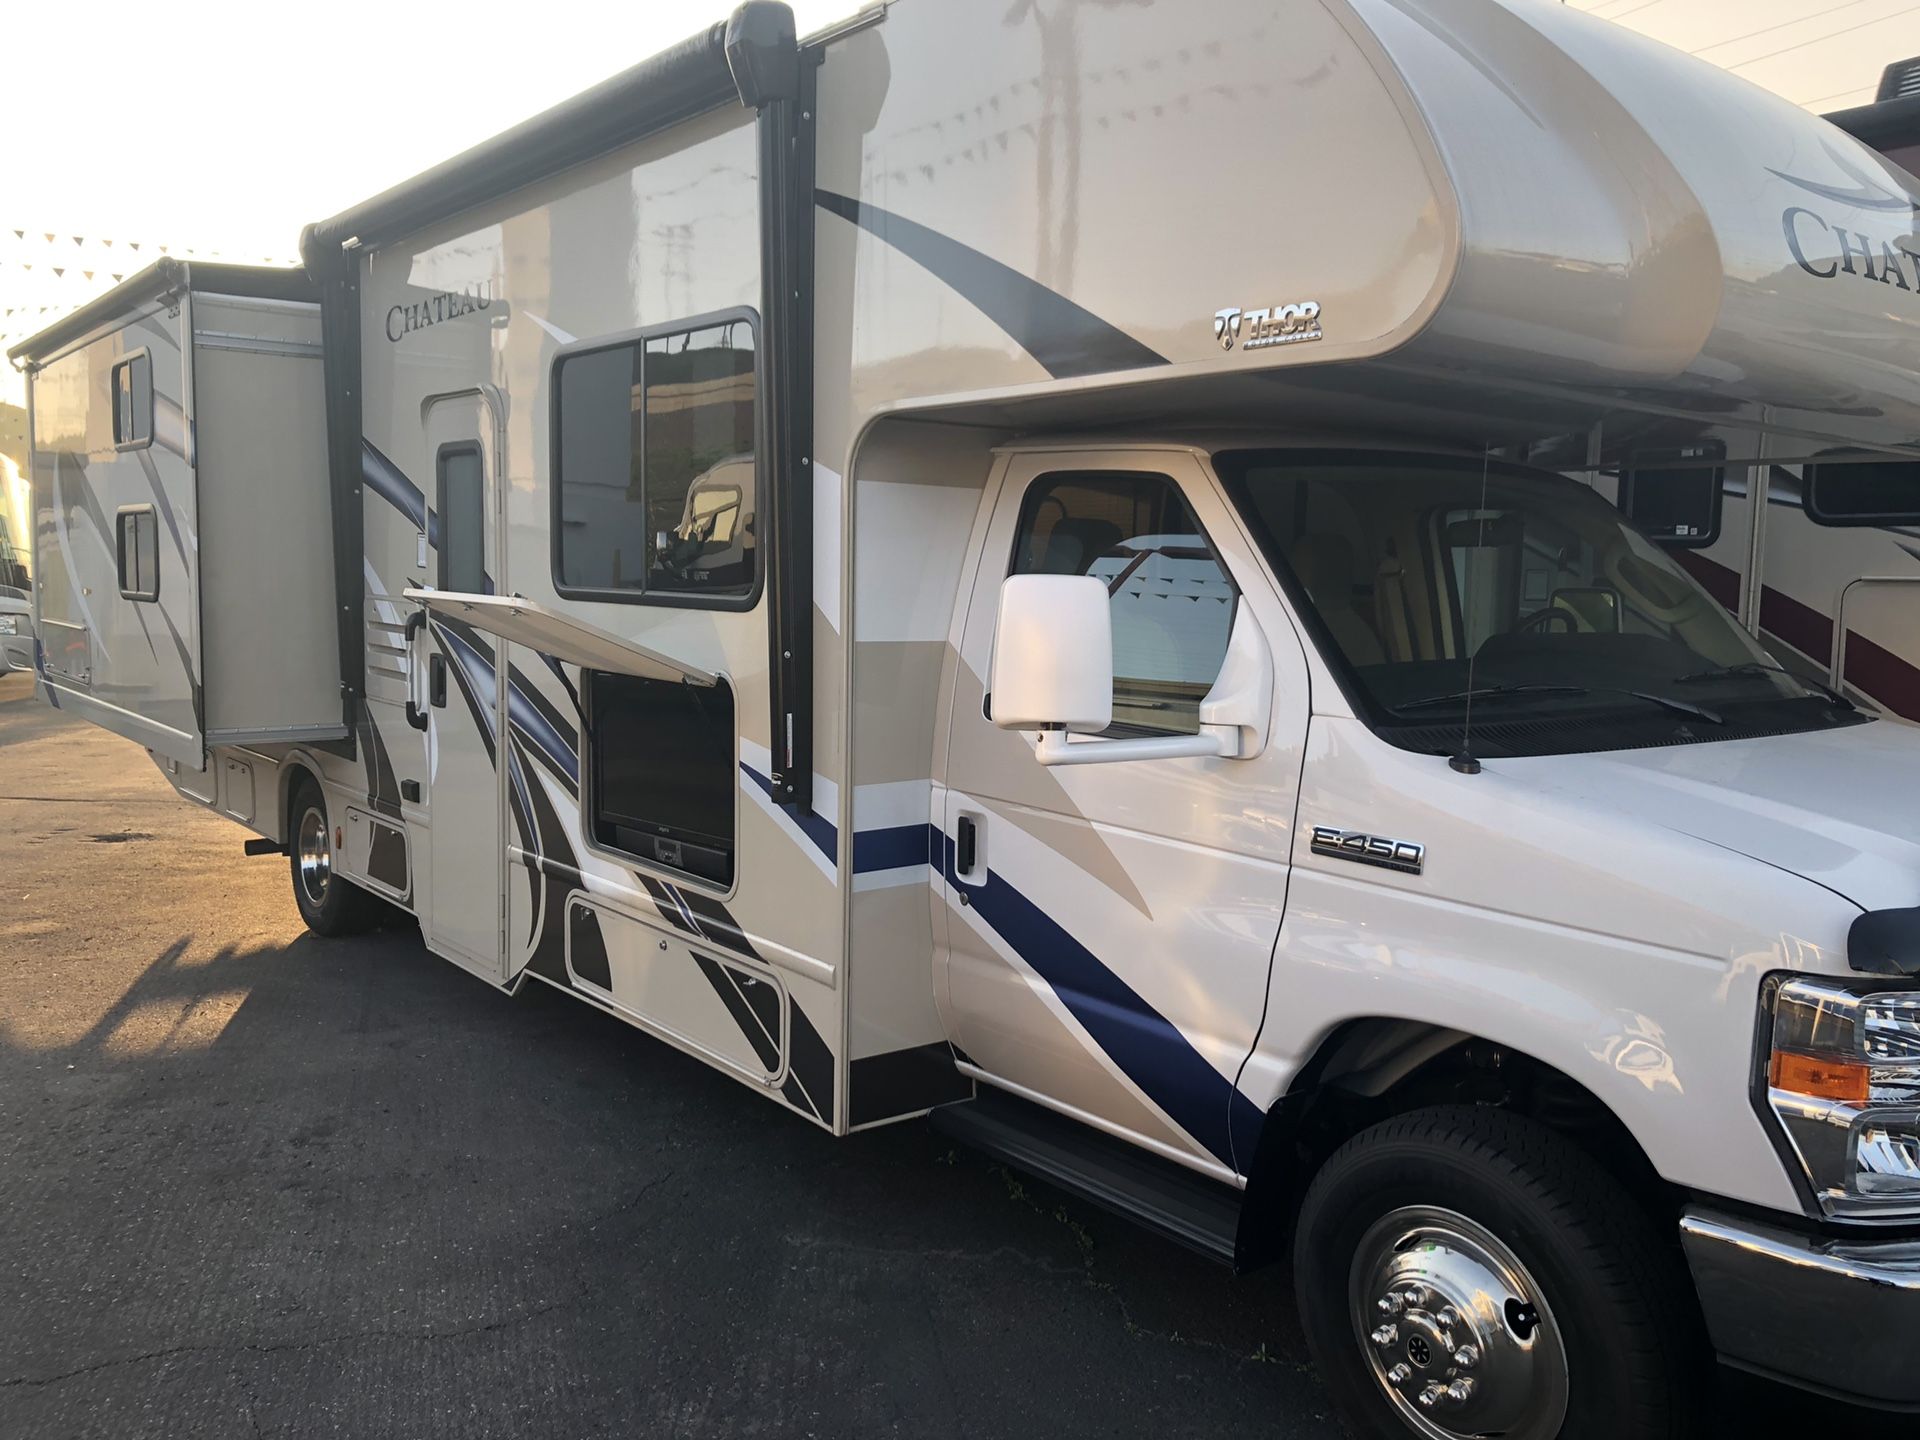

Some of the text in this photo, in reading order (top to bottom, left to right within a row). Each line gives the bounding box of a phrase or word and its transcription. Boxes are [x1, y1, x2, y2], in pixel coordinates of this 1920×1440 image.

[385, 280, 492, 342] CHATEAU
[1244, 301, 1321, 339] THOR
[1284, 332, 1320, 343] COACH
